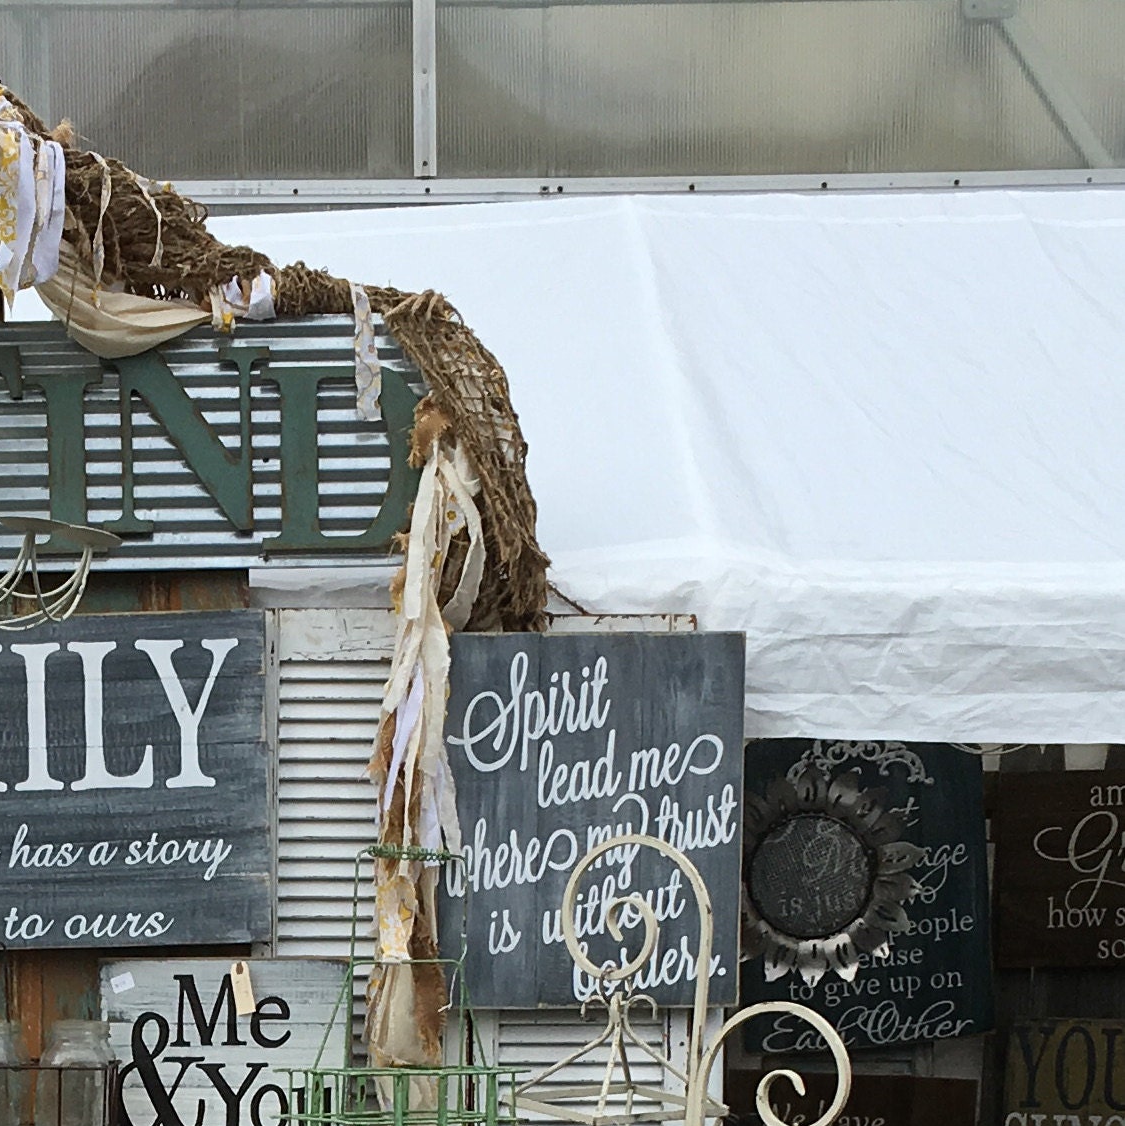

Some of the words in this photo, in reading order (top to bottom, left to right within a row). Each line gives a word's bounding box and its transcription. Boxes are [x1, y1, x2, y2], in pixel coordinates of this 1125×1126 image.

[447, 651, 612, 772] Spirit
[537, 729, 622, 808] lead
[628, 734, 724, 792] me
[8, 824, 84, 869] has
[87, 837, 119, 865] a
[124, 830, 232, 882] story
[446, 817, 578, 898] where
[655, 784, 738, 857] trust
[3, 905, 54, 941] to
[65, 907, 175, 940] ours
[489, 910, 521, 954] is
[1047, 896, 1107, 928] how
[171, 974, 291, 1048] Me
[788, 980, 814, 1001] to
[824, 976, 881, 1007] give
[890, 974, 921, 999] up
[930, 969, 963, 990] on
[867, 999, 975, 1045] Other
